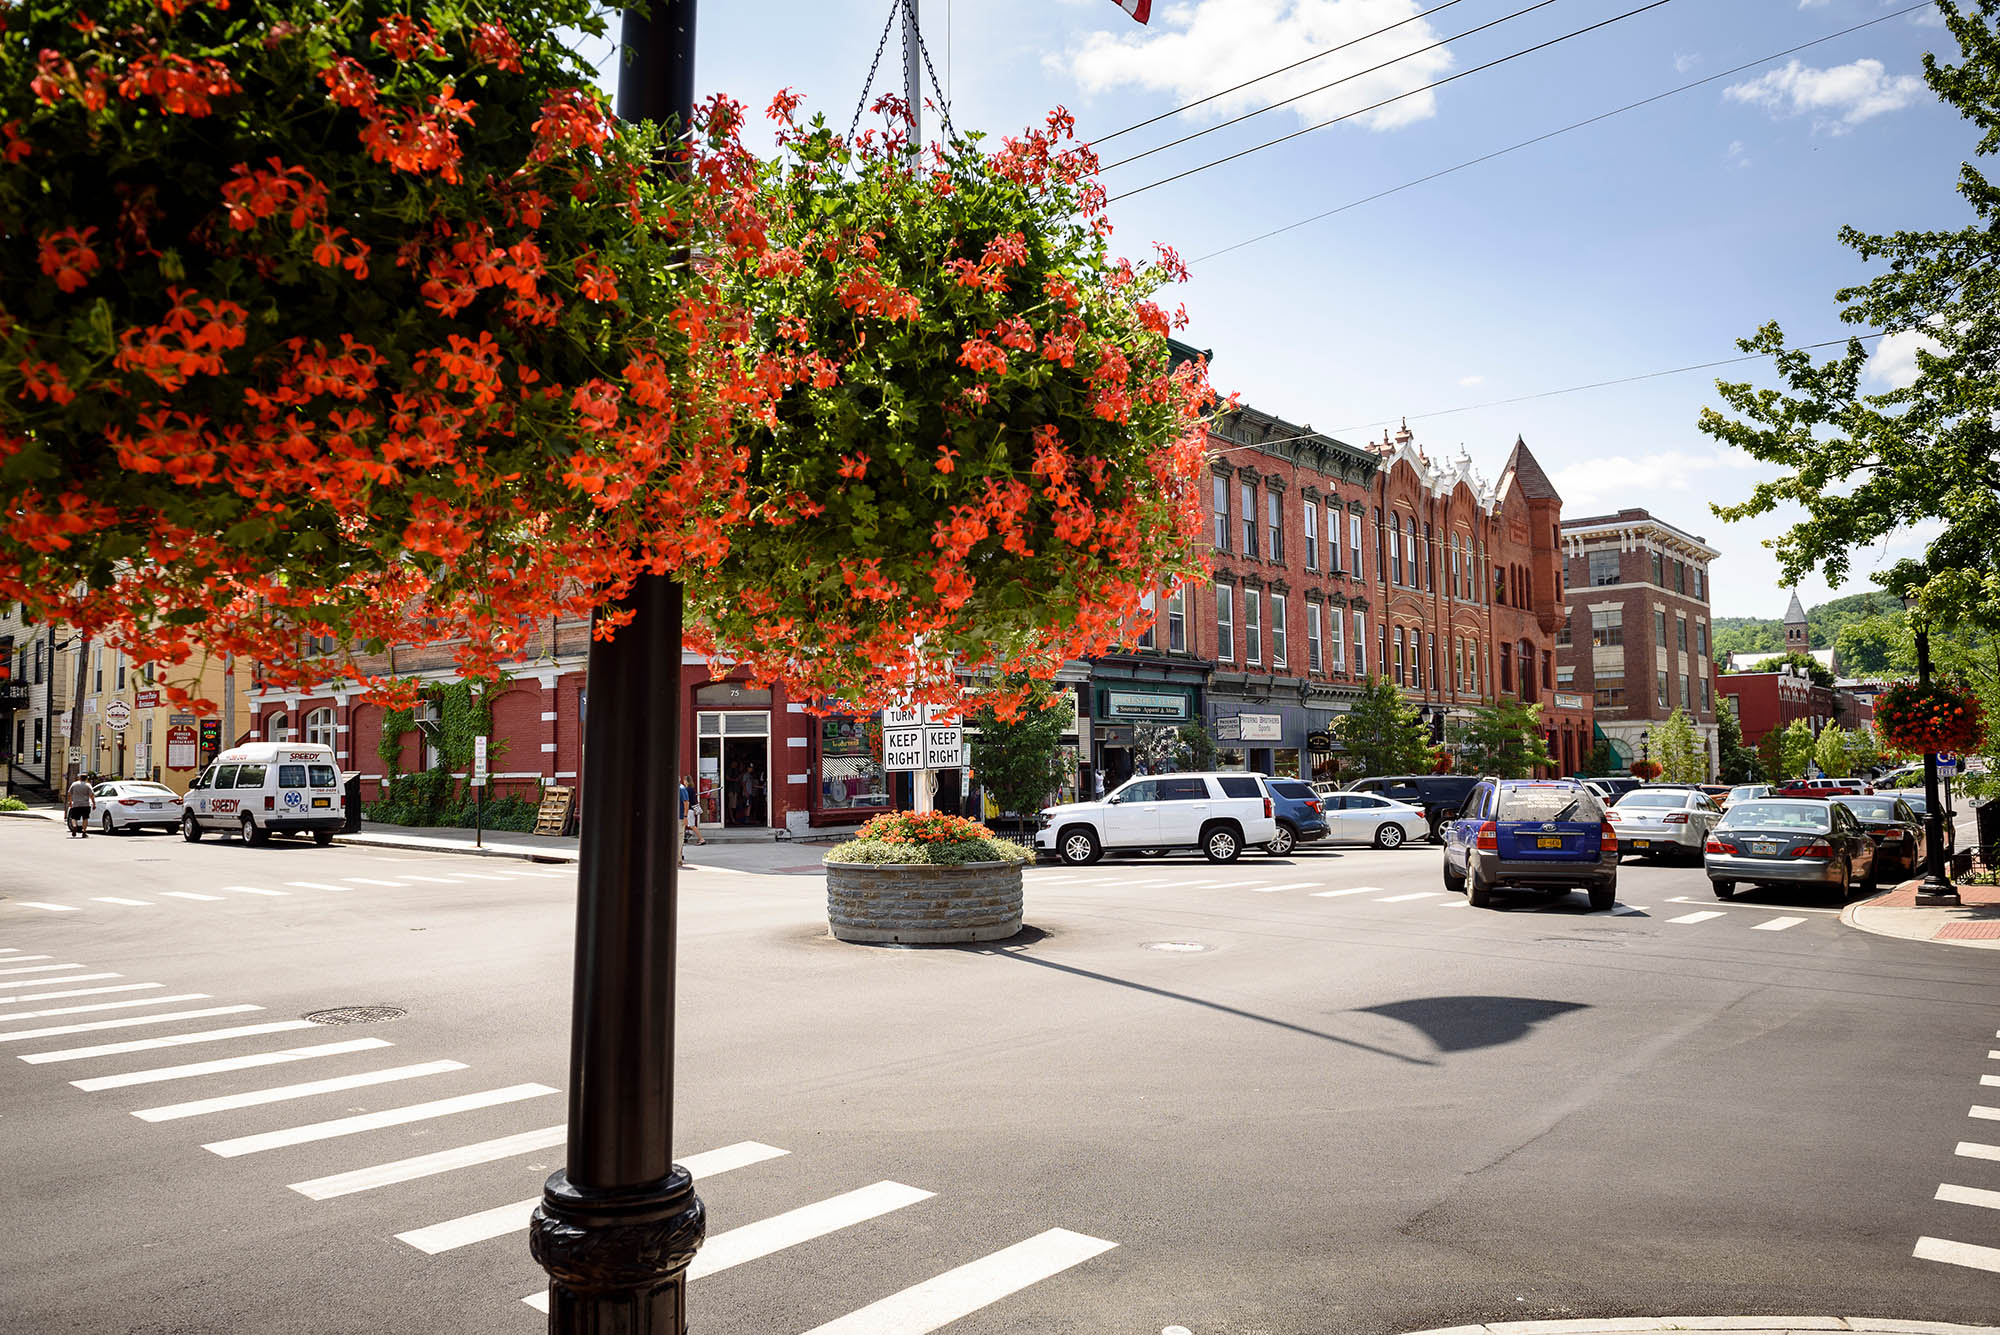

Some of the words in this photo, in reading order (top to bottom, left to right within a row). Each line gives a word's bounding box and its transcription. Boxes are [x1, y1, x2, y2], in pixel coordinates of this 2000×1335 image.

[890, 711, 914, 721] TURN
[889, 734, 918, 747] KEEP
[930, 732, 956, 745] KEEP
[289, 752, 320, 760] SPEEDY
[888, 751, 920, 765] RIGHT
[929, 750, 959, 763] RIGHT
[211, 799, 241, 813] SPEEDY
